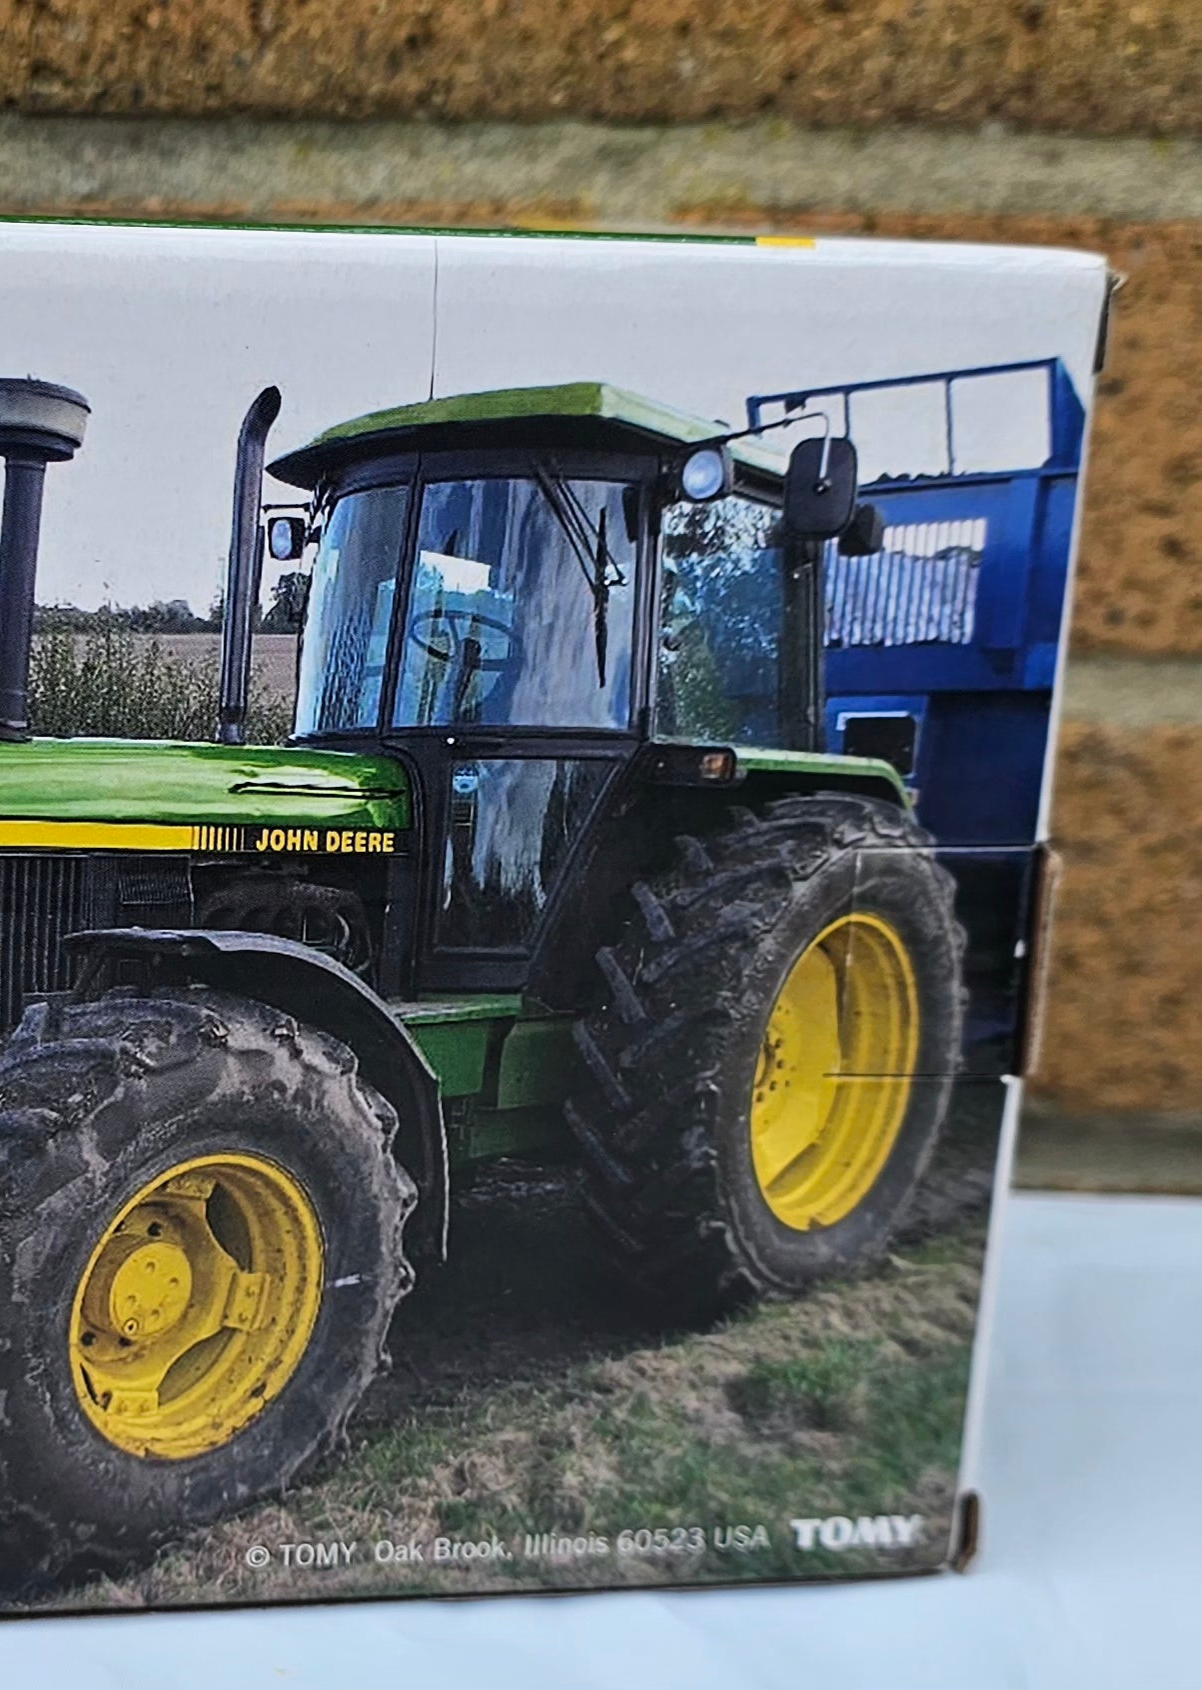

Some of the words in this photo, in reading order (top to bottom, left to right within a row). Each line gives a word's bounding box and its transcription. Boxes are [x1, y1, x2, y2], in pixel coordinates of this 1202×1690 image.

[256, 829, 318, 851] JOHN
[326, 831, 395, 852] DEERE
[279, 1542, 356, 1567] TOMY
[374, 1540, 424, 1563] Oak
[525, 1532, 609, 1557] Illinois
[617, 1528, 707, 1553] 60523
[714, 1524, 772, 1550] USA
[790, 1514, 926, 1549] TOMY
